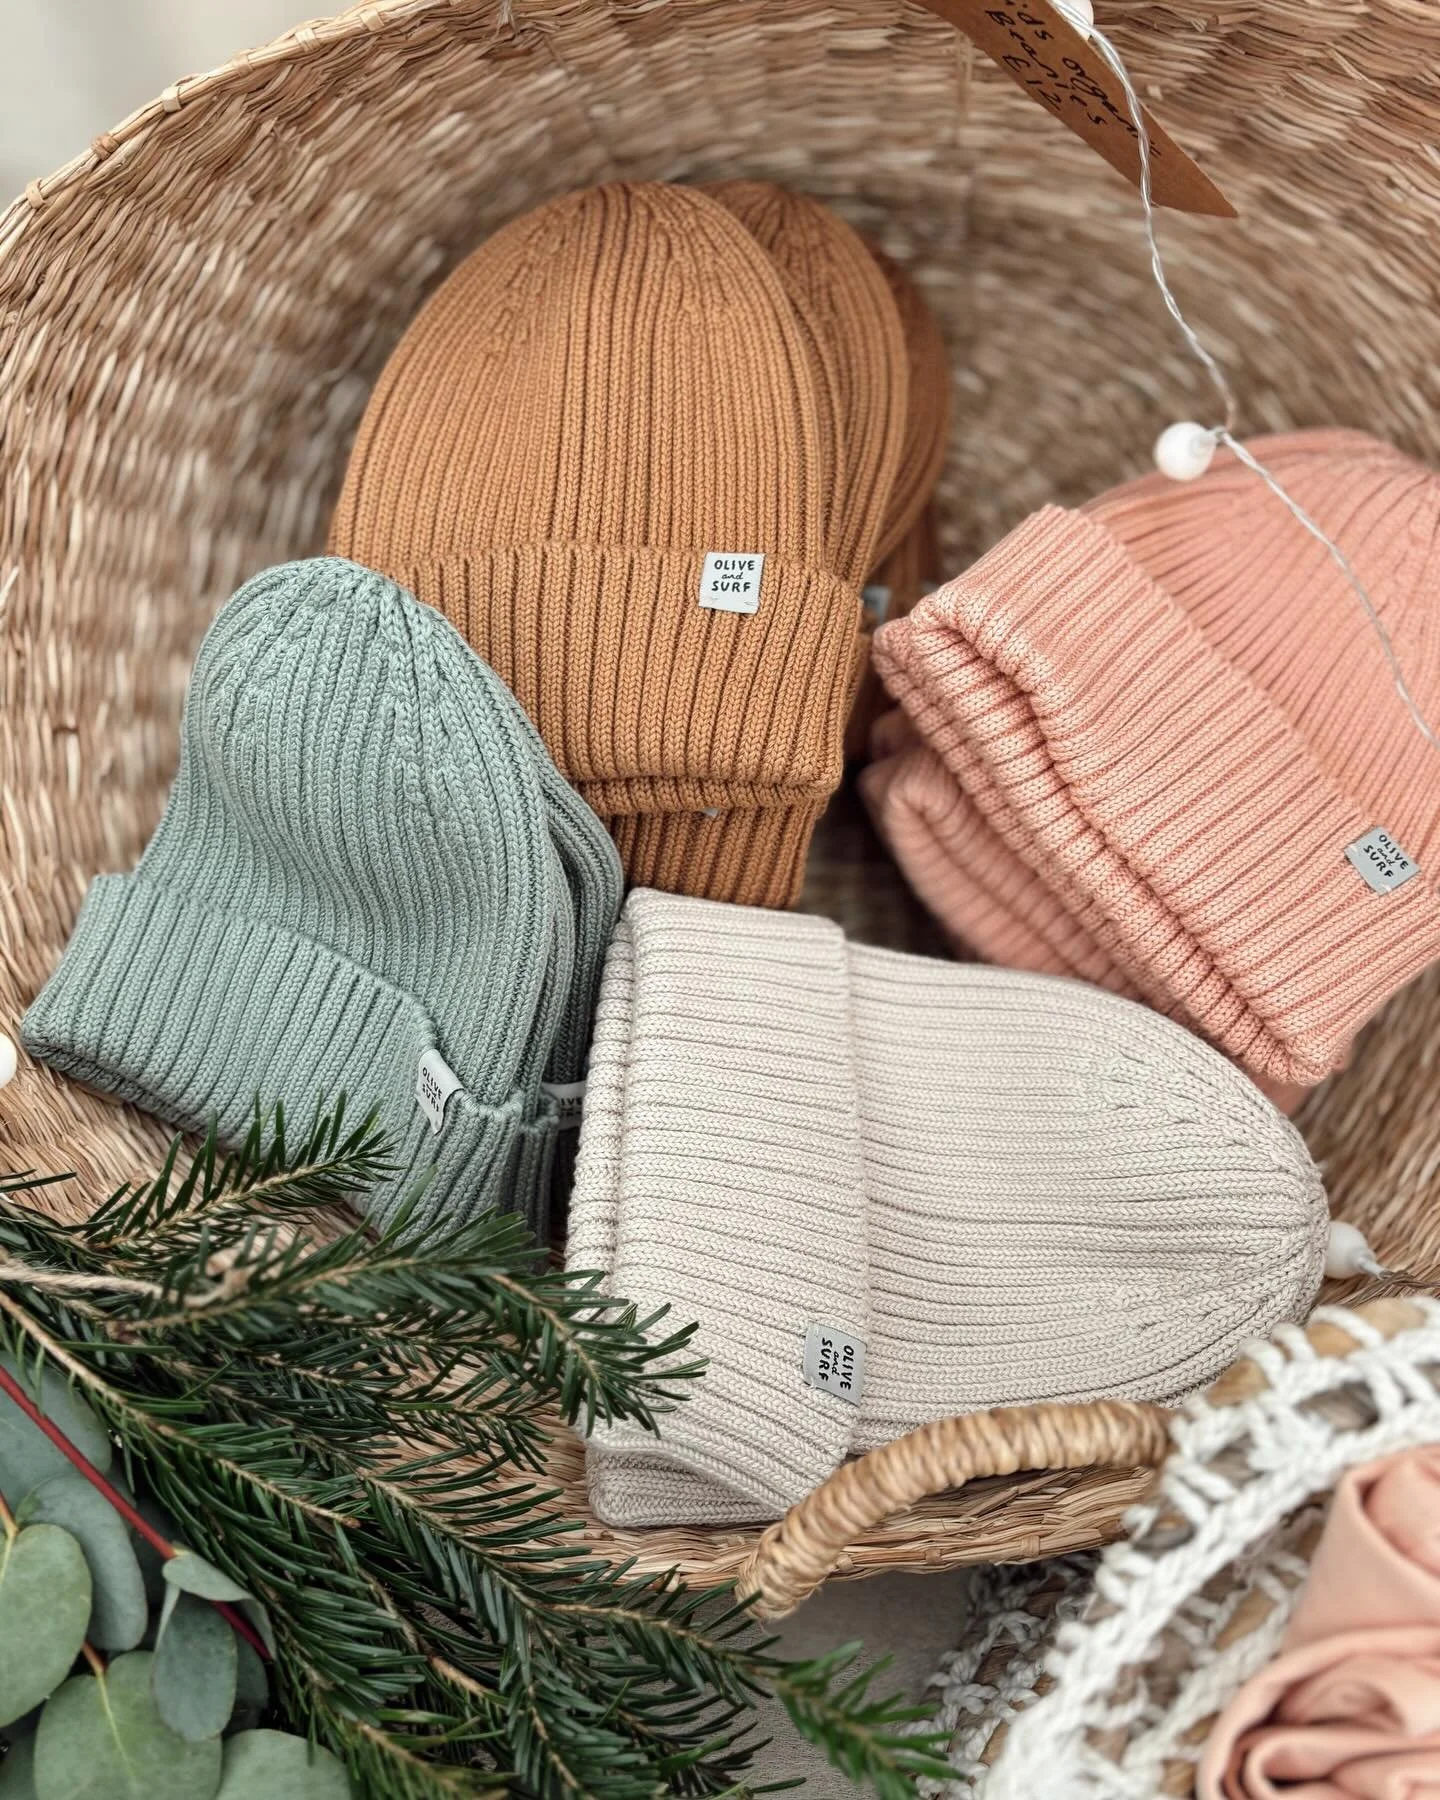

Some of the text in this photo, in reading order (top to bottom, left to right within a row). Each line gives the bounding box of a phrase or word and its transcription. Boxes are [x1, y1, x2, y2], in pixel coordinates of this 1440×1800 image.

[1004, 0, 1055, 41] ids
[714, 559, 755, 571] OLIVE
[721, 572, 744, 580] and
[711, 580, 751, 593] SURF
[1363, 845, 1394, 877] SURF
[1377, 848, 1395, 866] and
[1378, 834, 1409, 870] OLIVE
[422, 1067, 442, 1100] OLIVE
[818, 1337, 833, 1382] SURF
[831, 1350, 840, 1376] and
[840, 1345, 855, 1391] OLIVE
